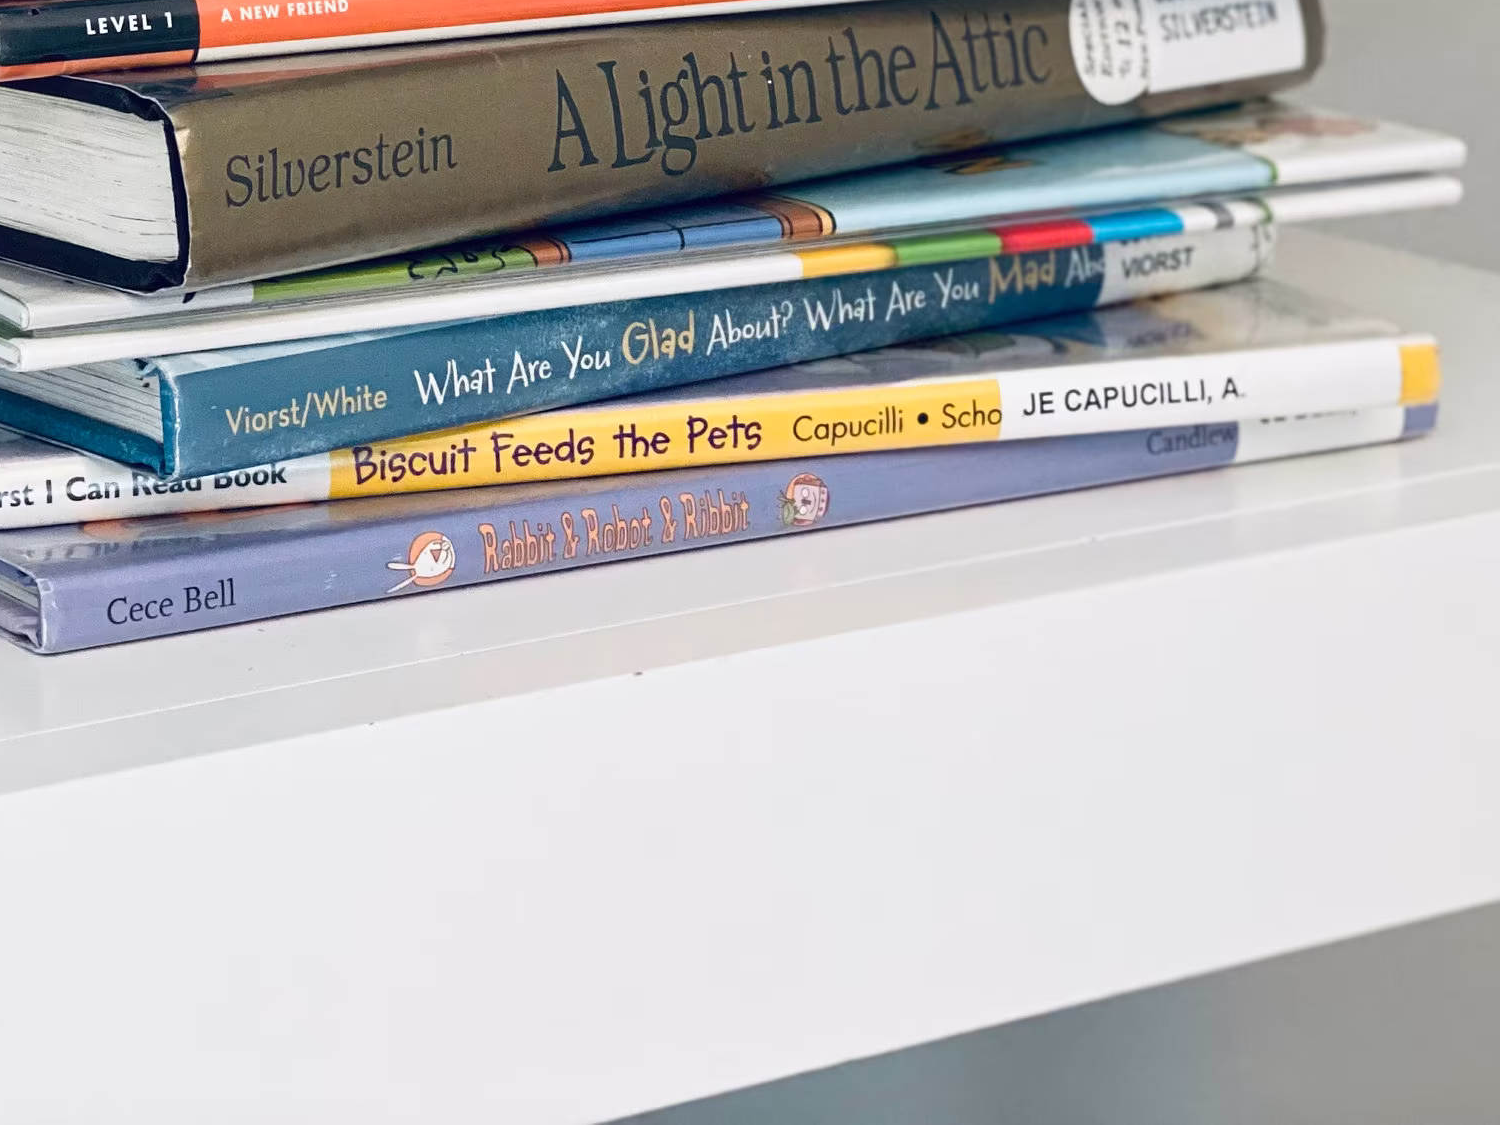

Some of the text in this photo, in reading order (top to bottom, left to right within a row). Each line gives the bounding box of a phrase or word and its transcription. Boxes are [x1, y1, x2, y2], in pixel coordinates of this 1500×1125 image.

[85, 13, 152, 36] LEVEL
[165, 11, 173, 29] 1
[220, 7, 232, 23] A
[239, 3, 279, 22] NEW
[1158, 0, 1279, 43] SILVERSTEIN
[547, 68, 600, 172] A
[596, 51, 757, 176] Light
[763, 49, 823, 130] in
[825, 26, 920, 116] the
[923, 10, 1053, 111] Attic
[225, 127, 458, 208] Silverstein
[1122, 247, 1195, 279] VIORST
[225, 384, 389, 436] Viorst/White
[414, 360, 495, 406] What
[507, 350, 553, 394] Are
[561, 336, 611, 379] You
[622, 309, 696, 365] Glad
[706, 300, 794, 356] About?
[803, 288, 877, 331] What
[885, 283, 927, 323] Are
[934, 268, 980, 309] You
[988, 251, 1056, 304] Mad
[1022, 377, 1246, 417] JE CAPUCILLI, A.
[46, 479, 54, 504] I
[66, 477, 121, 502] Can
[214, 463, 288, 490] Book
[353, 438, 477, 485] Biscuit
[491, 428, 596, 473] Feeds
[612, 423, 671, 458] the
[686, 415, 763, 454] Pets
[792, 405, 905, 446] Capucilli
[941, 399, 1003, 430] Scho
[478, 488, 751, 574] Rabbit & Robot & Ribbit
[106, 578, 236, 626] Cece Bell
